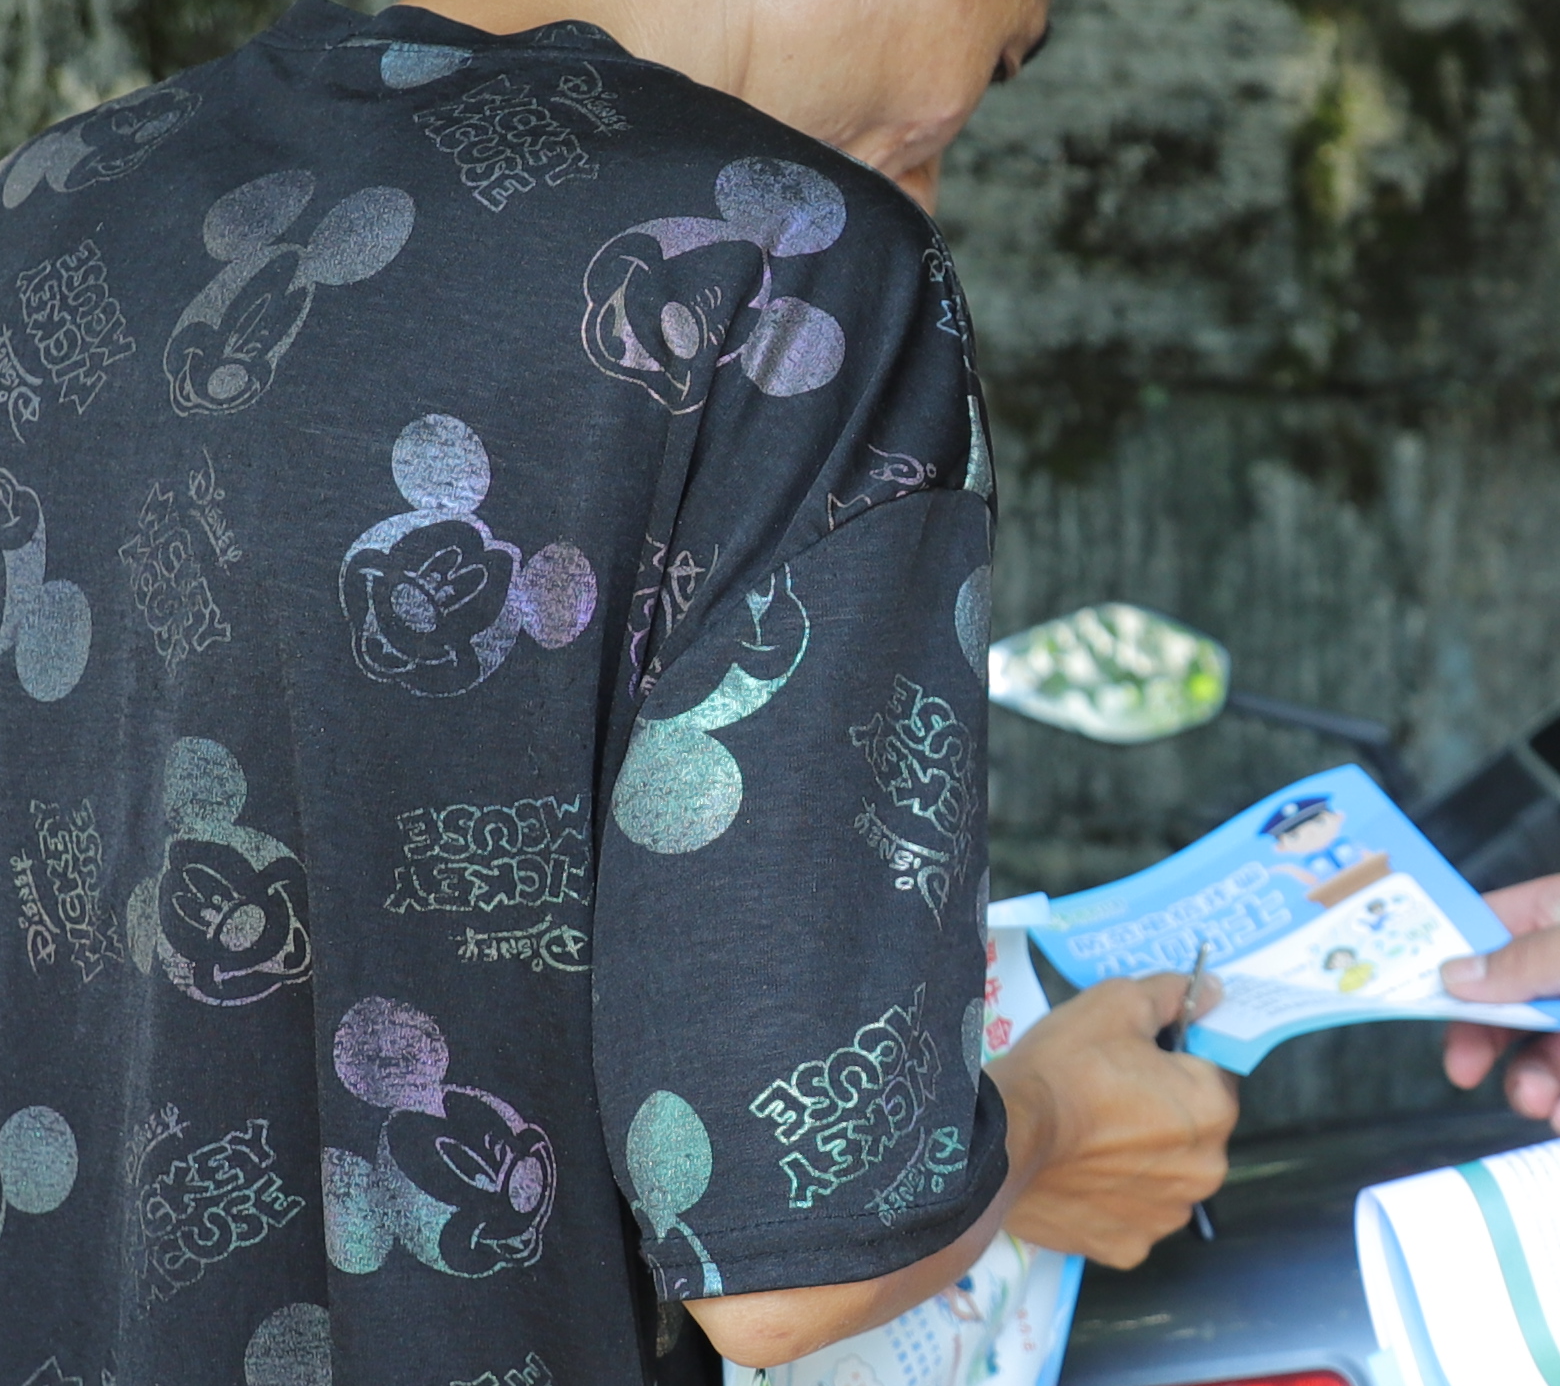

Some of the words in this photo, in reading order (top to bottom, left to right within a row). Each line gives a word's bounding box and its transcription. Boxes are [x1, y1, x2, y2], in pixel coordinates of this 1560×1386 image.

[413, 105, 535, 212] MOUSE
[463, 75, 598, 188] MICKEY
[395, 793, 592, 861] MOUSE
